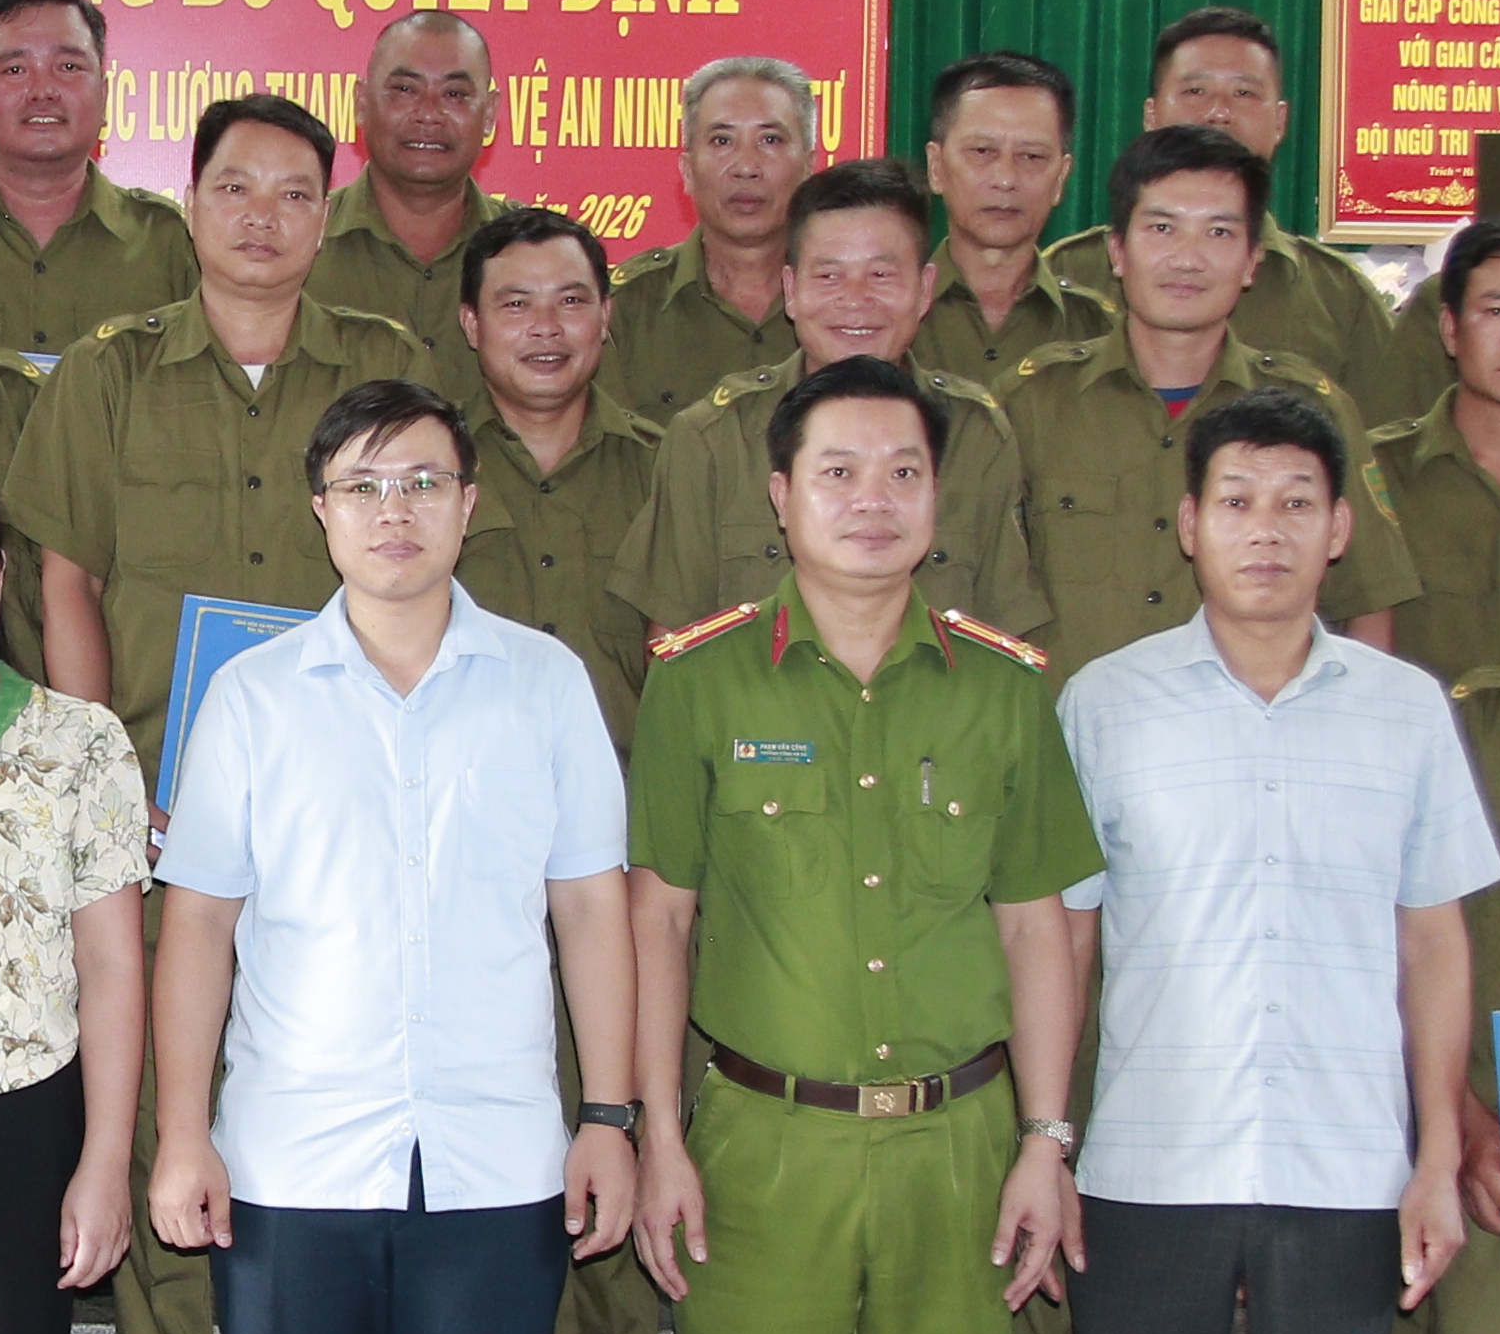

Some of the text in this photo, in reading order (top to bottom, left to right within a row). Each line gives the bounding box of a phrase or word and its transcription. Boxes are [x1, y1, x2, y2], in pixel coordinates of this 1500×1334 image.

[1399, 34, 1431, 67] VỚI
[1436, 41, 1474, 68] GIAI
[508, 58, 548, 163] VỆ
[558, 77, 602, 147] AN
[1393, 80, 1447, 111] NÔNG
[1452, 81, 1492, 112] DÂN
[1356, 123, 1469, 159] ĐỘI NGŨ TRI
[579, 194, 651, 239] 2026
